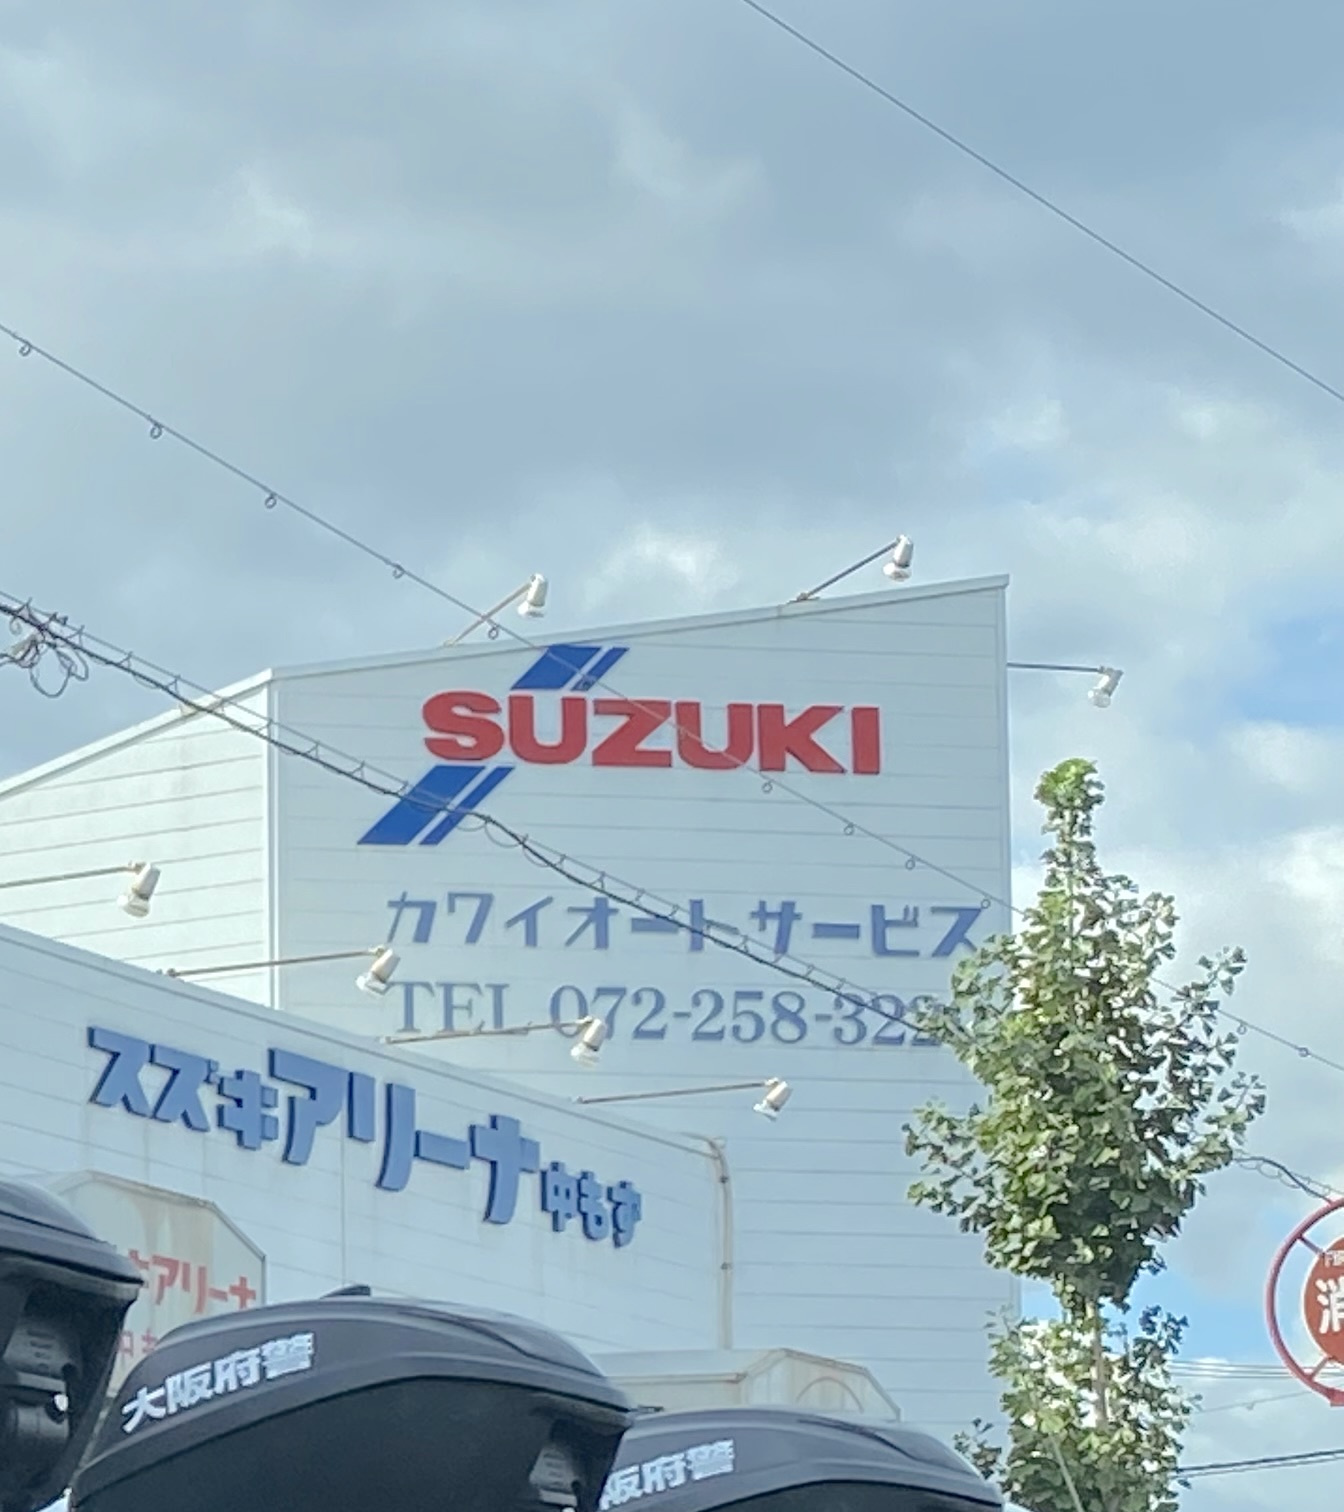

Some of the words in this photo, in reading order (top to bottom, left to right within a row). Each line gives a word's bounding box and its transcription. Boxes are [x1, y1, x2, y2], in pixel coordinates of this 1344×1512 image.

[422, 690, 881, 775] SUZUKI
[386, 980, 528, 1034] TEL
[121, 1333, 316, 1433] 大阪府警
[599, 1440, 735, 1510] 阪府警
